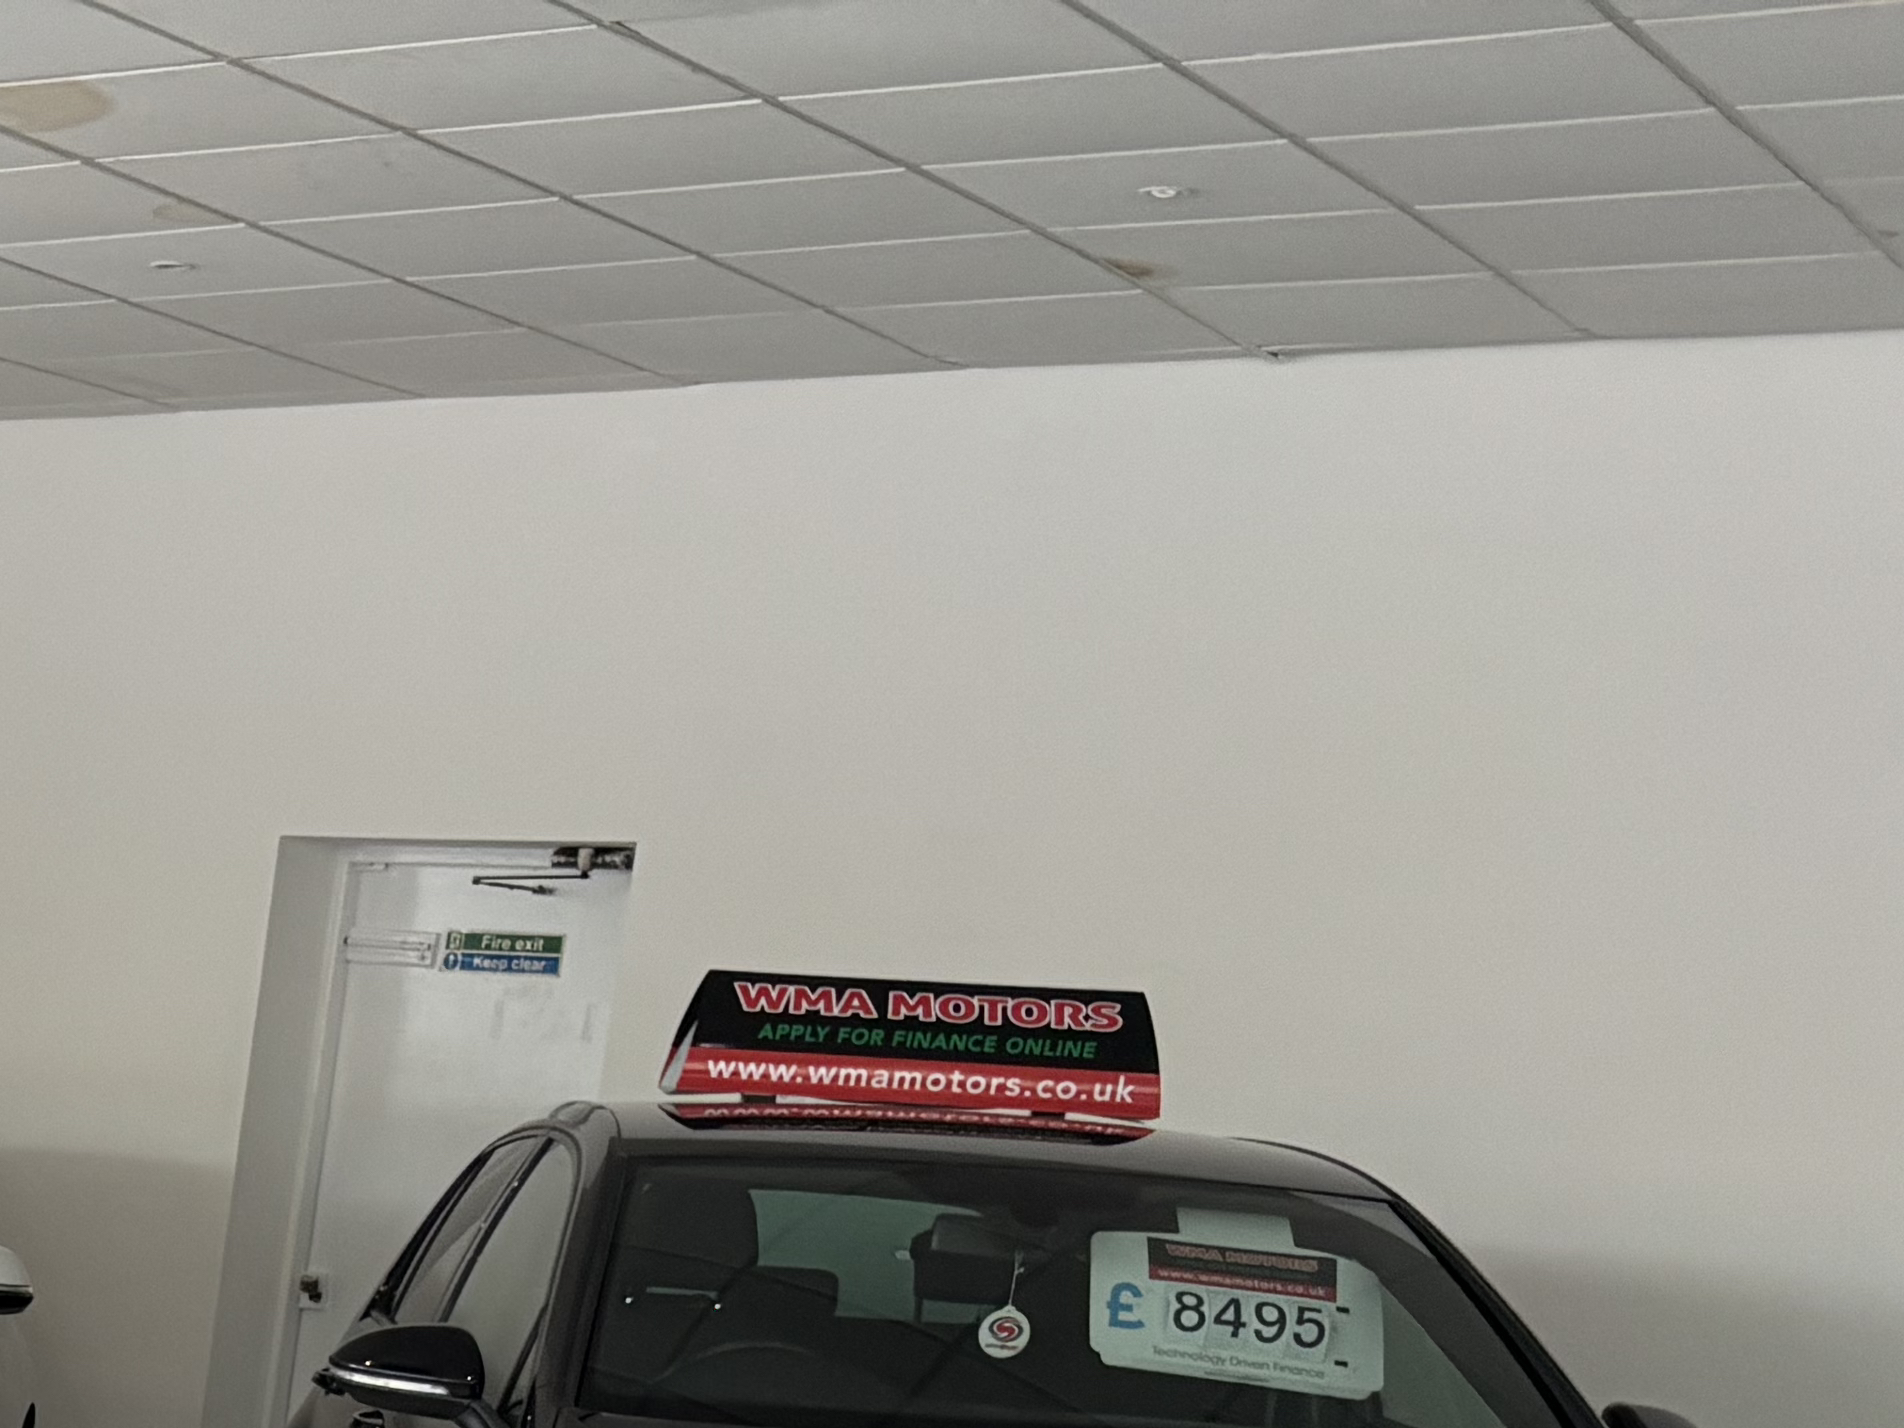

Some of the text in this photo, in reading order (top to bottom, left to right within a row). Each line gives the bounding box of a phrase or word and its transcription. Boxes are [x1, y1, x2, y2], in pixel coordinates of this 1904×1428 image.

[473, 954, 546, 971] Keep clear
[482, 936, 544, 952] Fire exit
[734, 981, 1123, 1032] WMA MOTORS
[758, 1023, 1098, 1060] APPLY FOR FINANCE ONLINE
[707, 1059, 1134, 1104] www.wmamotors.co.uk
[1106, 1282, 1326, 1348] £ 8495
